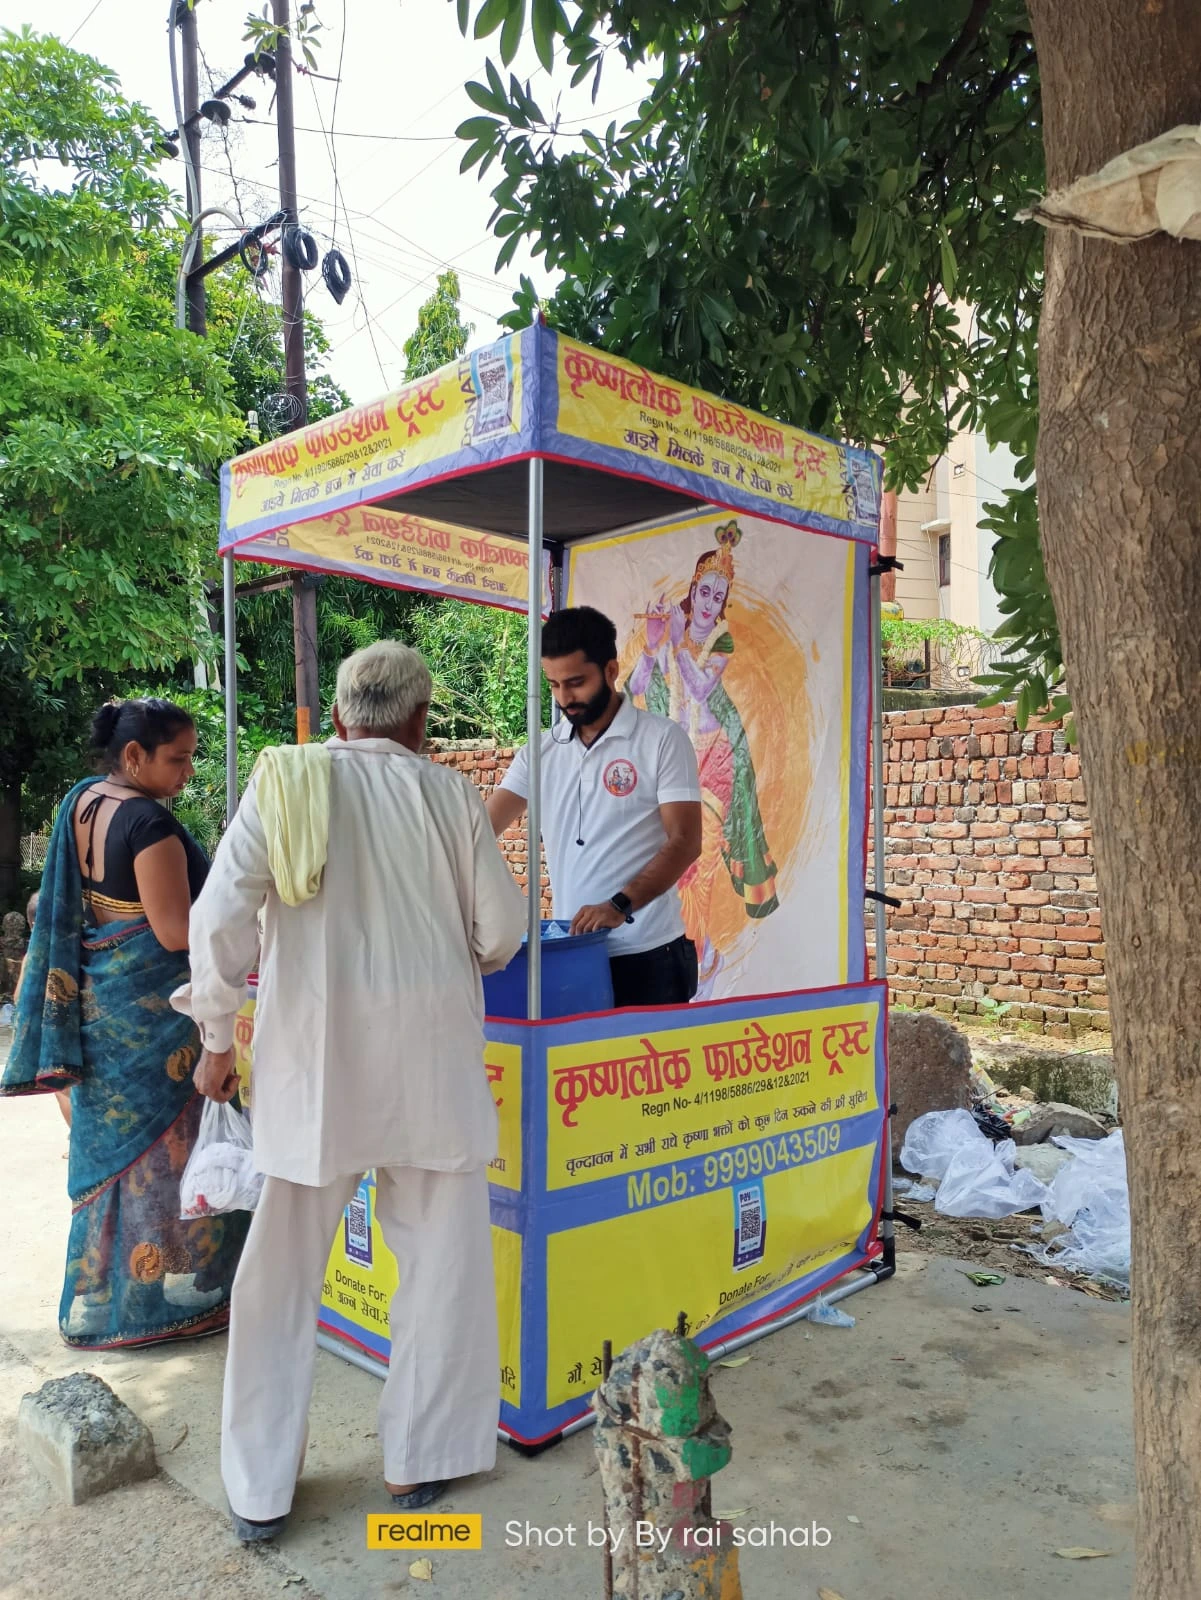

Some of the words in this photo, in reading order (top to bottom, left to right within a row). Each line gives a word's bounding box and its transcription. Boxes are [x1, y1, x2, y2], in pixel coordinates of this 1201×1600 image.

[396, 375, 446, 438] ट्रस्ट
[564, 346, 682, 418] कृष्णलोक
[691, 395, 785, 460] फाउंडेशन
[791, 437, 828, 481] ट्रस्ट
[639, 411, 665, 429] Regn
[290, 481, 320, 505] मिलके
[361, 463, 382, 482] सेवा
[386, 450, 407, 473] करें
[623, 429, 660, 452] आइये
[665, 437, 705, 467] मिलके
[711, 457, 731, 479] ब्रज
[750, 469, 772, 493] सेवा
[776, 481, 795, 501] करें
[553, 1038, 691, 1127] कृष्णलोक
[702, 1022, 812, 1082] फाउंडेशन
[822, 1021, 870, 1076] ट्रस्ट
[641, 1102, 670, 1117] Regn
[673, 1096, 692, 1110] No-
[693, 1071, 810, 1106] 4/1198/5886/29&12&2021
[566, 1150, 614, 1177] वृन्दावन
[619, 1143, 629, 1160] में
[634, 1137, 656, 1157] सभी
[661, 1132, 678, 1150] राधे
[683, 1129, 709, 1149] कृष्णा
[713, 1120, 733, 1138] भक्तों
[738, 1116, 750, 1132] को
[754, 1113, 771, 1132] कुछ
[774, 1109, 789, 1124] दिन
[793, 1101, 817, 1117] रुकने
[820, 1098, 833, 1112] की
[627, 1165, 696, 1209] Mob:
[703, 1123, 841, 1188] 9999043509
[335, 1269, 366, 1295] Donate
[368, 1284, 387, 1304] For:
[337, 1291, 357, 1311] अन्न
[719, 1281, 752, 1306] Donate
